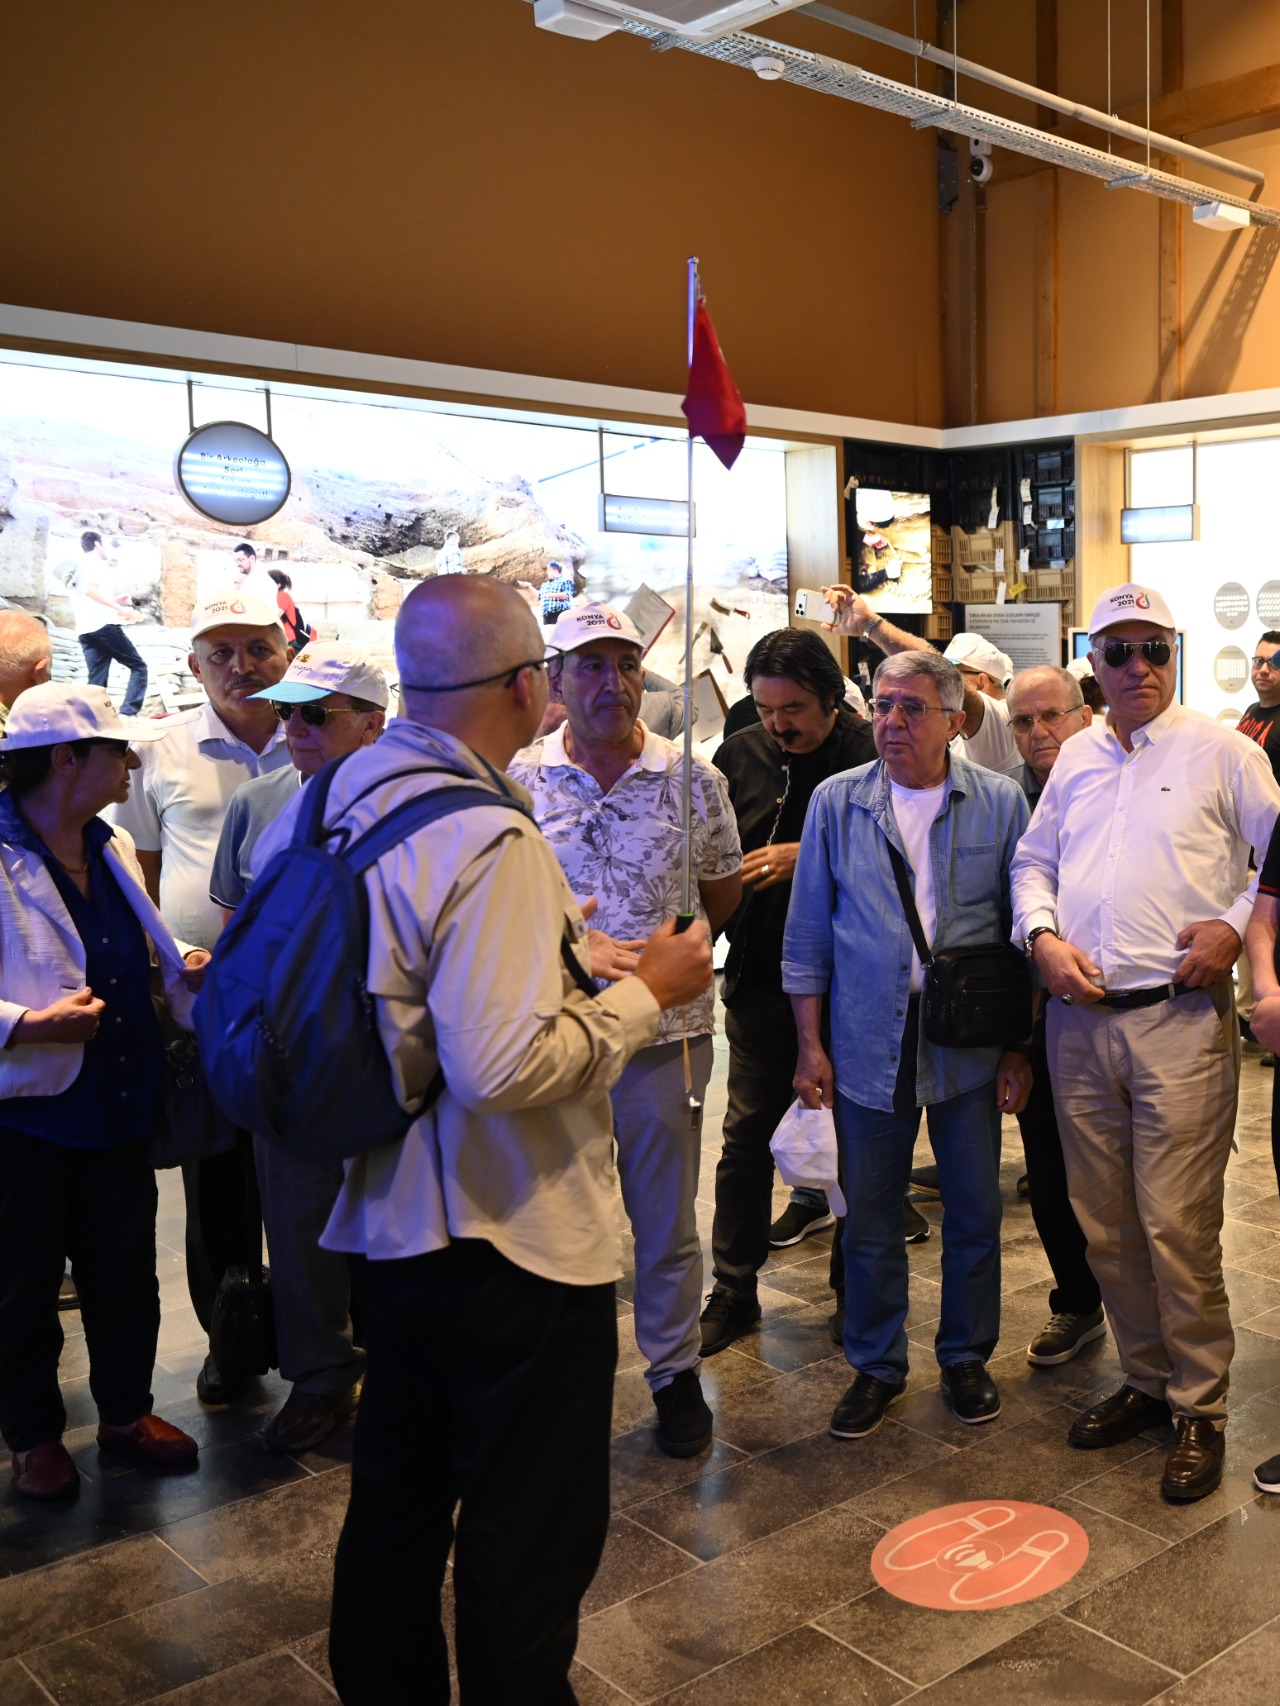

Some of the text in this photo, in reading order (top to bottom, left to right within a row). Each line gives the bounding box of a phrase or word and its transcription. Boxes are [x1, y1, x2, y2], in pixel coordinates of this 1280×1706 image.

[200, 452, 214, 461] Bir
[1110, 594, 1134, 603] KONYA
[1118, 599, 1135, 607] 2021
[204, 600, 227, 611] KONYA
[576, 614, 604, 622] KONYA
